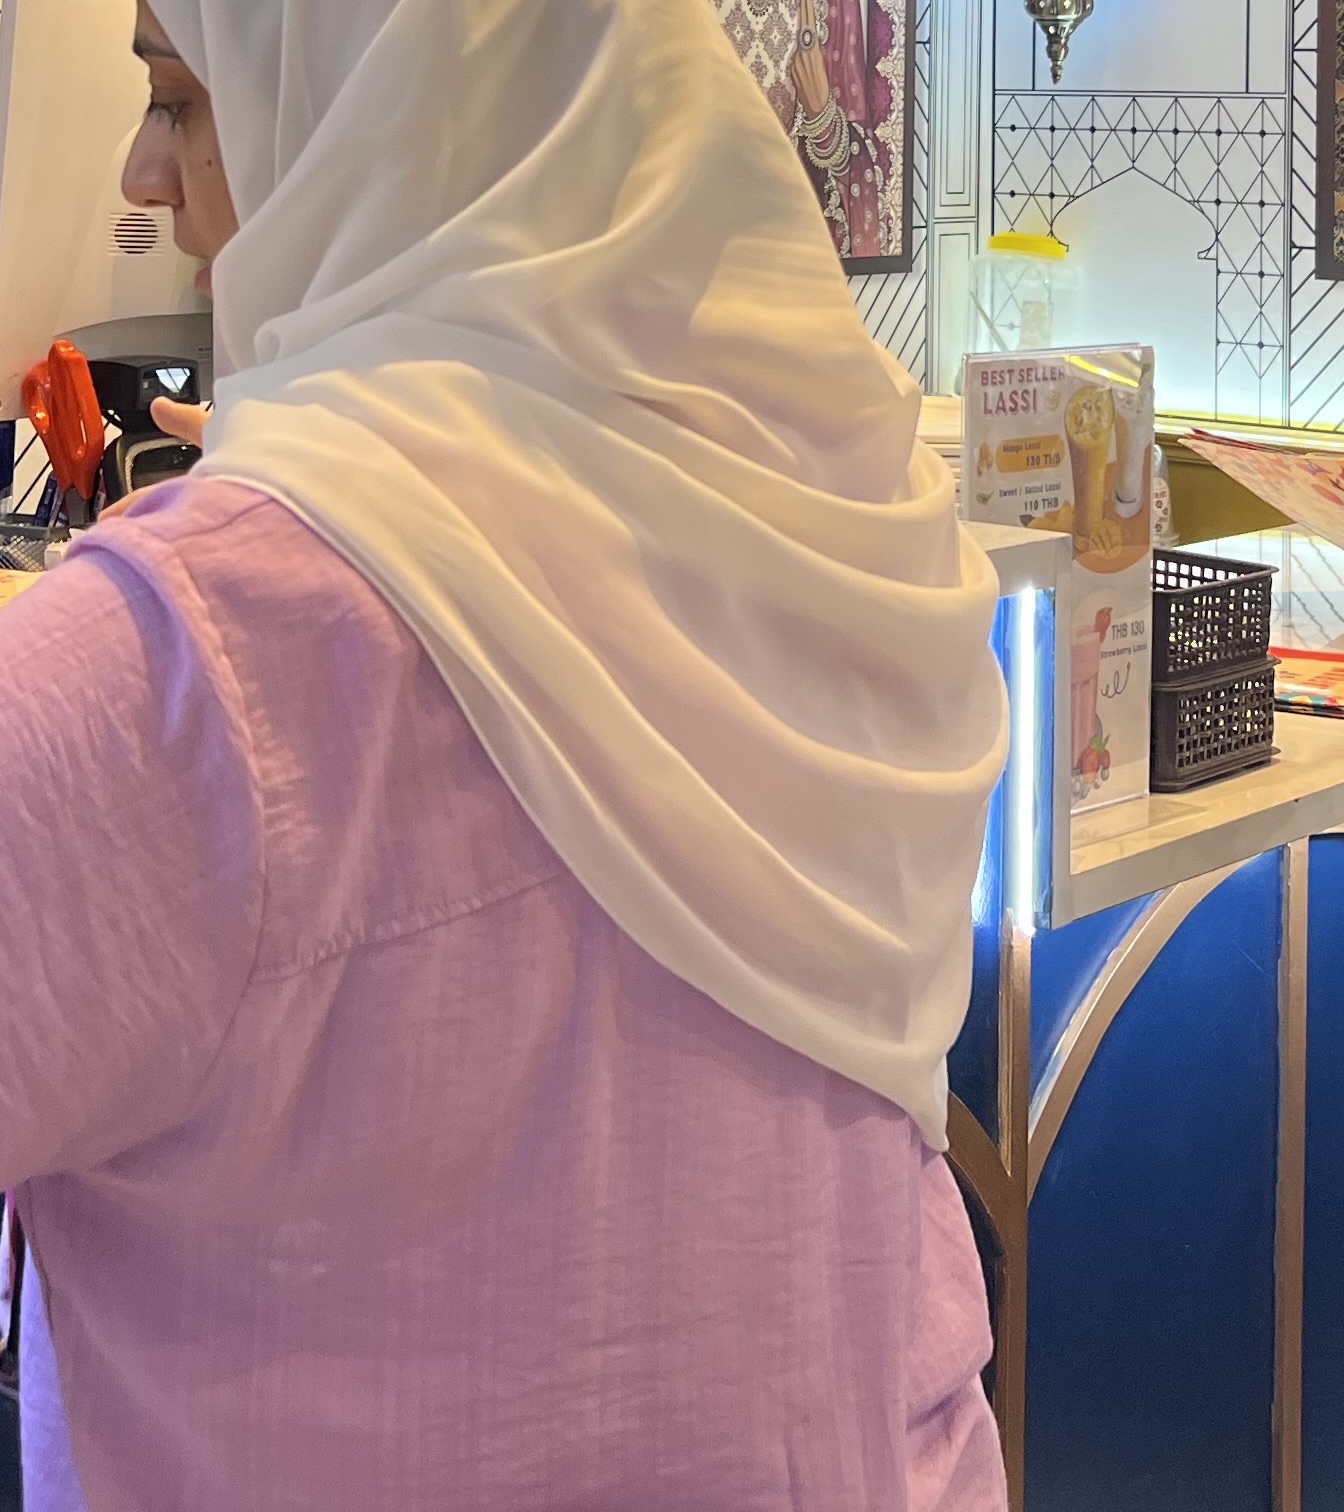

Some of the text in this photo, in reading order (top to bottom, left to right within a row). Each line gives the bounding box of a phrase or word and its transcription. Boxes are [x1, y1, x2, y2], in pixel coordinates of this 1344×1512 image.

[981, 368, 1016, 387] BEST
[983, 388, 1039, 416] LASSI
[1042, 497, 1059, 510] THB
[1111, 620, 1145, 641] THB 130
